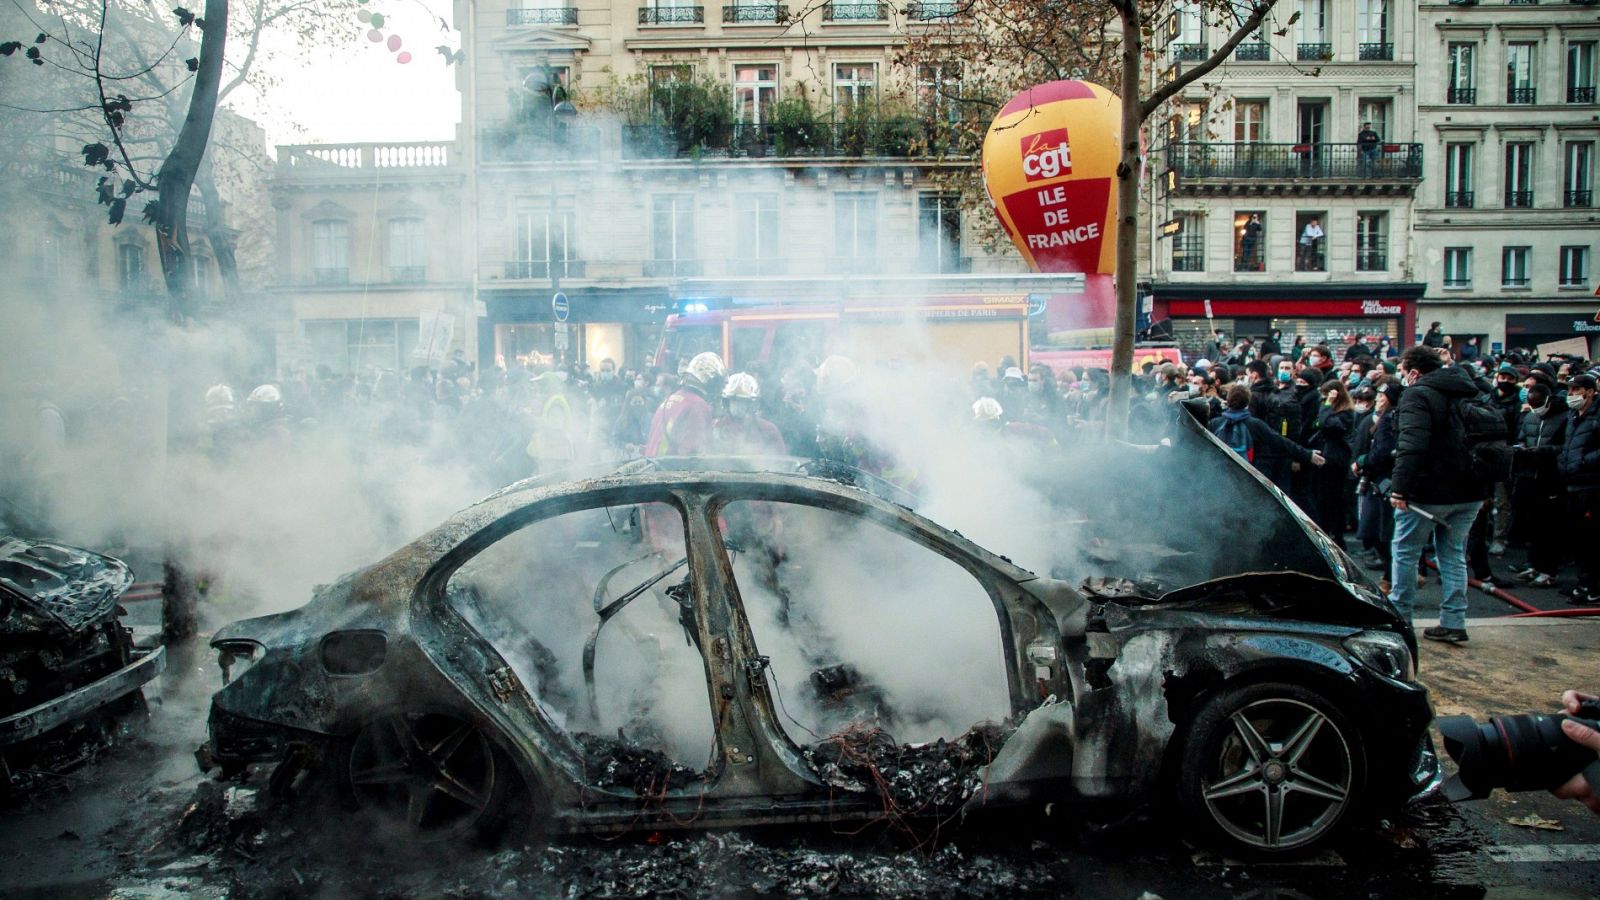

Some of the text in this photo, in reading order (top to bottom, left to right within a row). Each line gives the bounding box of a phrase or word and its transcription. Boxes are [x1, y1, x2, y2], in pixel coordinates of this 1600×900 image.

[1024, 134, 1050, 156] la
[1023, 142, 1072, 178] cgt
[1038, 186, 1067, 206] ILE
[1043, 208, 1070, 227] DE
[1027, 222, 1100, 249] FRANCE
